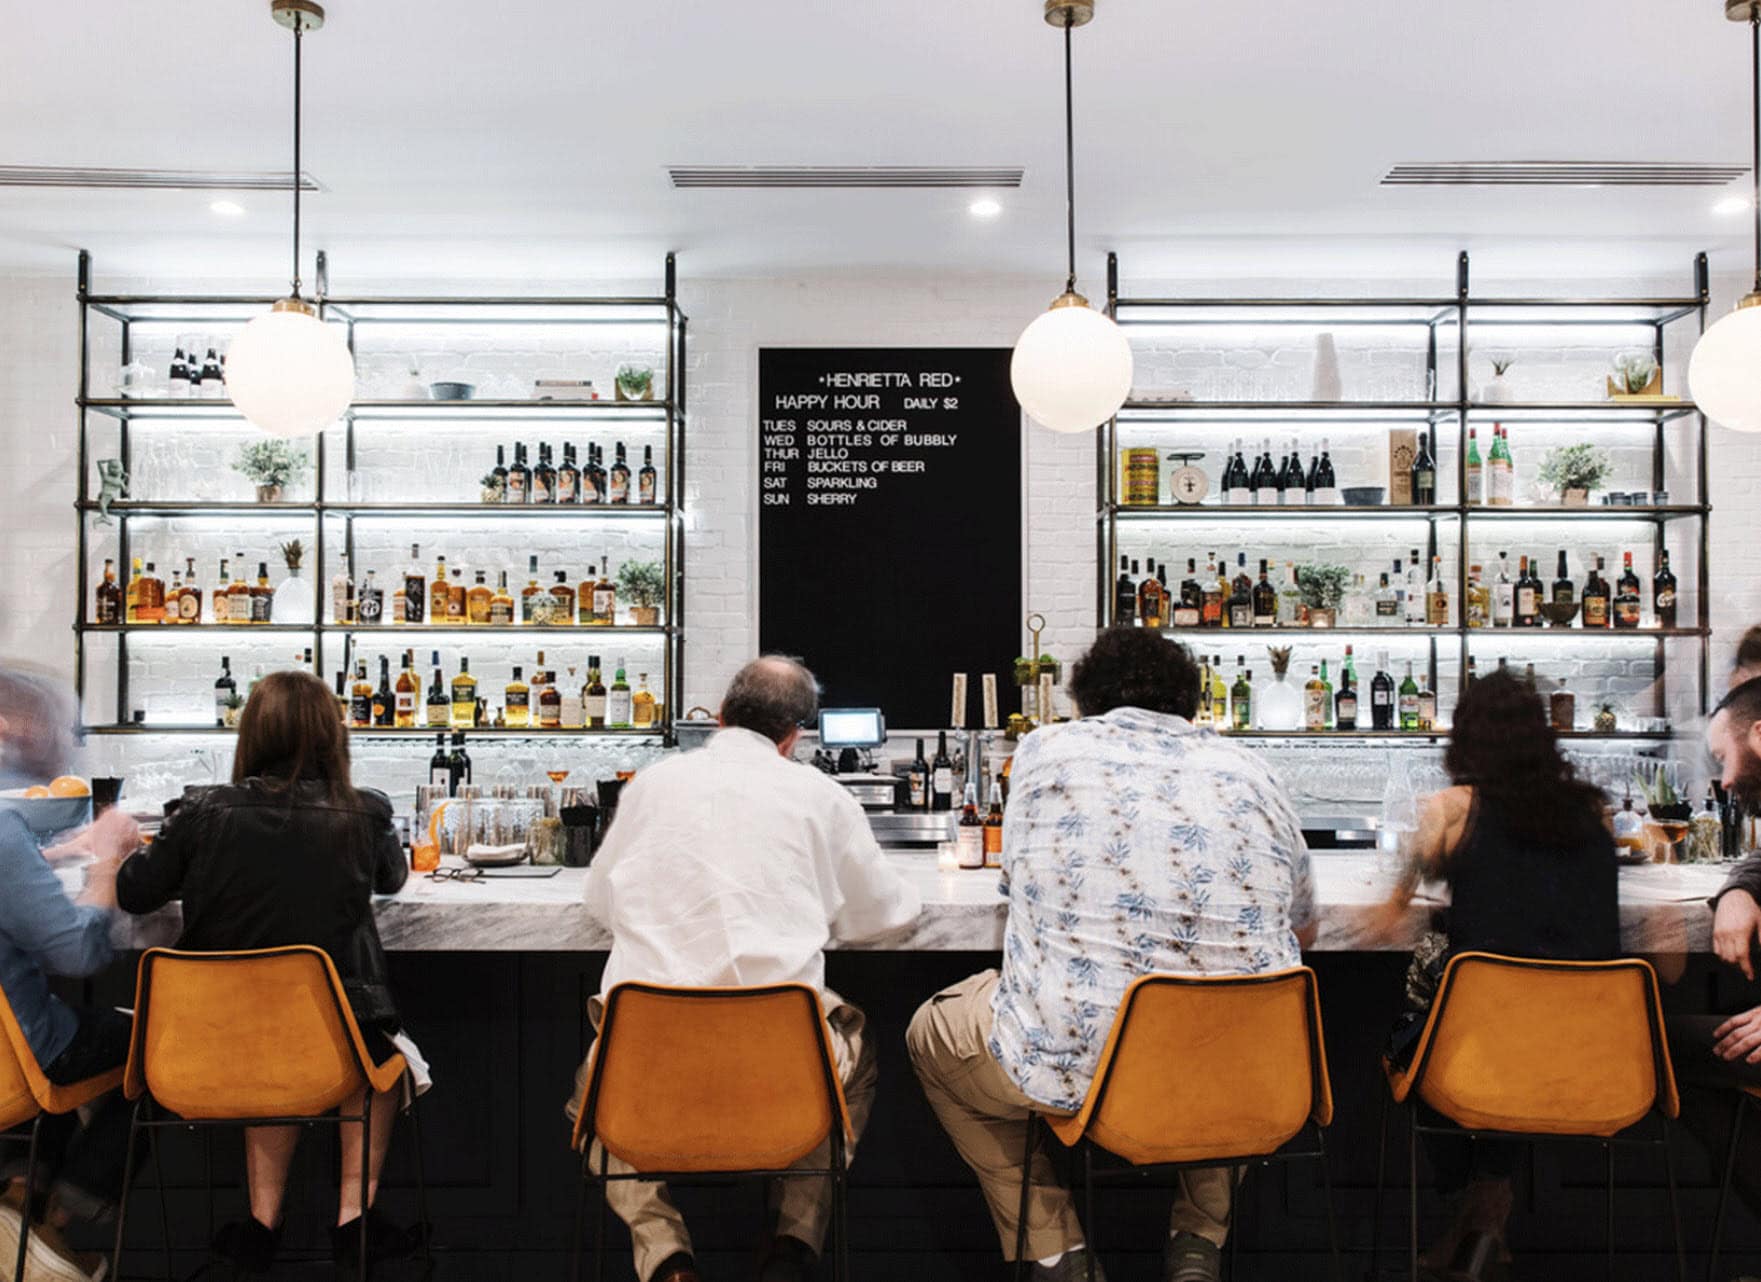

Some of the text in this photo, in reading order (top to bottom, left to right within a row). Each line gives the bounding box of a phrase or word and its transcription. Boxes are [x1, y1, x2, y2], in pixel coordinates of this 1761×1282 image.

[776, 395, 958, 409] HAPPY HOUR DAILY $2
[763, 420, 907, 431] TUES SOURS & CIDER
[764, 434, 957, 446] WED BOTTLES OF BUBBLY
[765, 448, 848, 459] THUR JELLO
[765, 461, 925, 472] FRI BUCKETS OF BEER
[764, 477, 877, 488] SAT SPARKLING
[764, 493, 857, 504] SUN SHERRY
